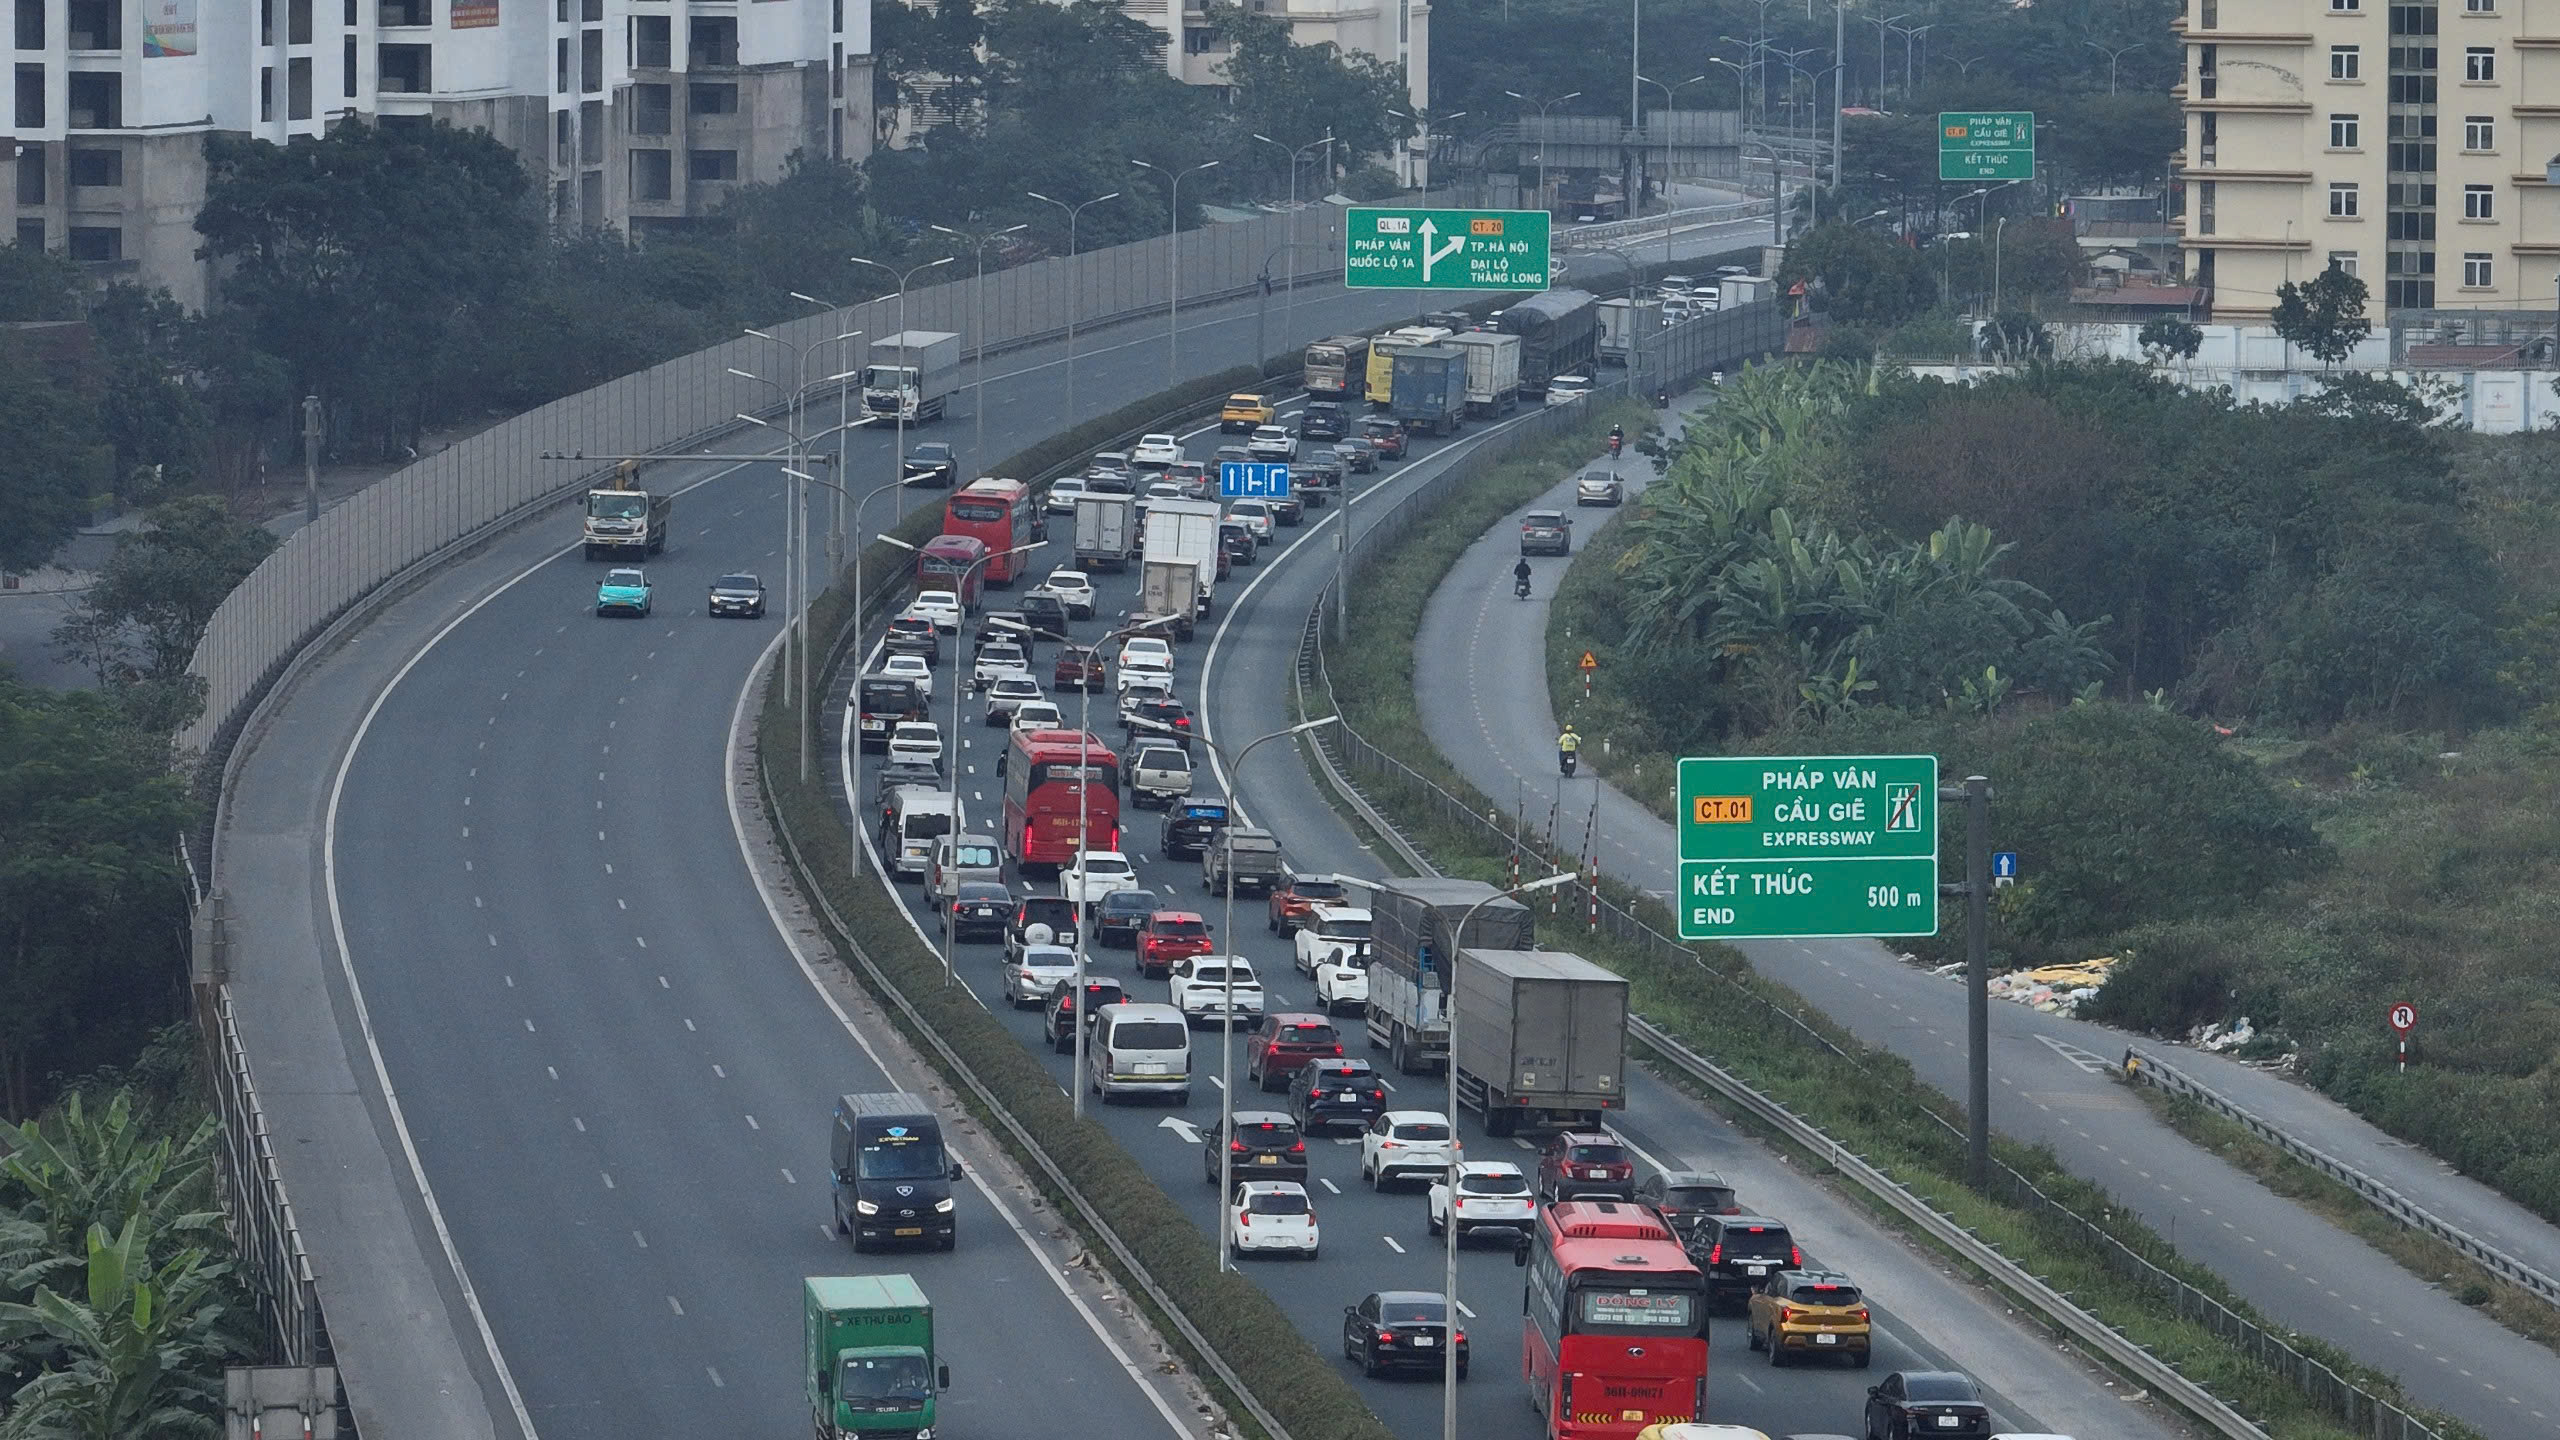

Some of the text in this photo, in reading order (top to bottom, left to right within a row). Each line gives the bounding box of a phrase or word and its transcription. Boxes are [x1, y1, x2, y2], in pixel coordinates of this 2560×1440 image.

[1969, 115, 2012, 126] PHÁP VÂN
[1965, 152, 2009, 165] KẾT THÚC
[1979, 167, 1995, 175] END
[1355, 237, 1411, 251] PHÁP VÂN
[1470, 239, 1529, 256] TP.HÀ NỘI
[1349, 253, 1415, 271] QUỐC LỘ 1A
[1470, 256, 1509, 272] ĐẠI LỘ
[1470, 270, 1542, 284] THĂNG LONG
[1762, 764, 1877, 790] PHÁP VÂN
[1701, 801, 1747, 819] CT.01
[1774, 795, 1866, 823] CẦU GIẼ
[1762, 831, 1876, 847] EXPRESSWAY
[1693, 865, 1814, 896] KẾT THÚC
[1867, 886, 1921, 908] 500 m
[1693, 908, 1735, 925] END
[847, 1316, 860, 1327] XE
[862, 1313, 886, 1327] THƯ
